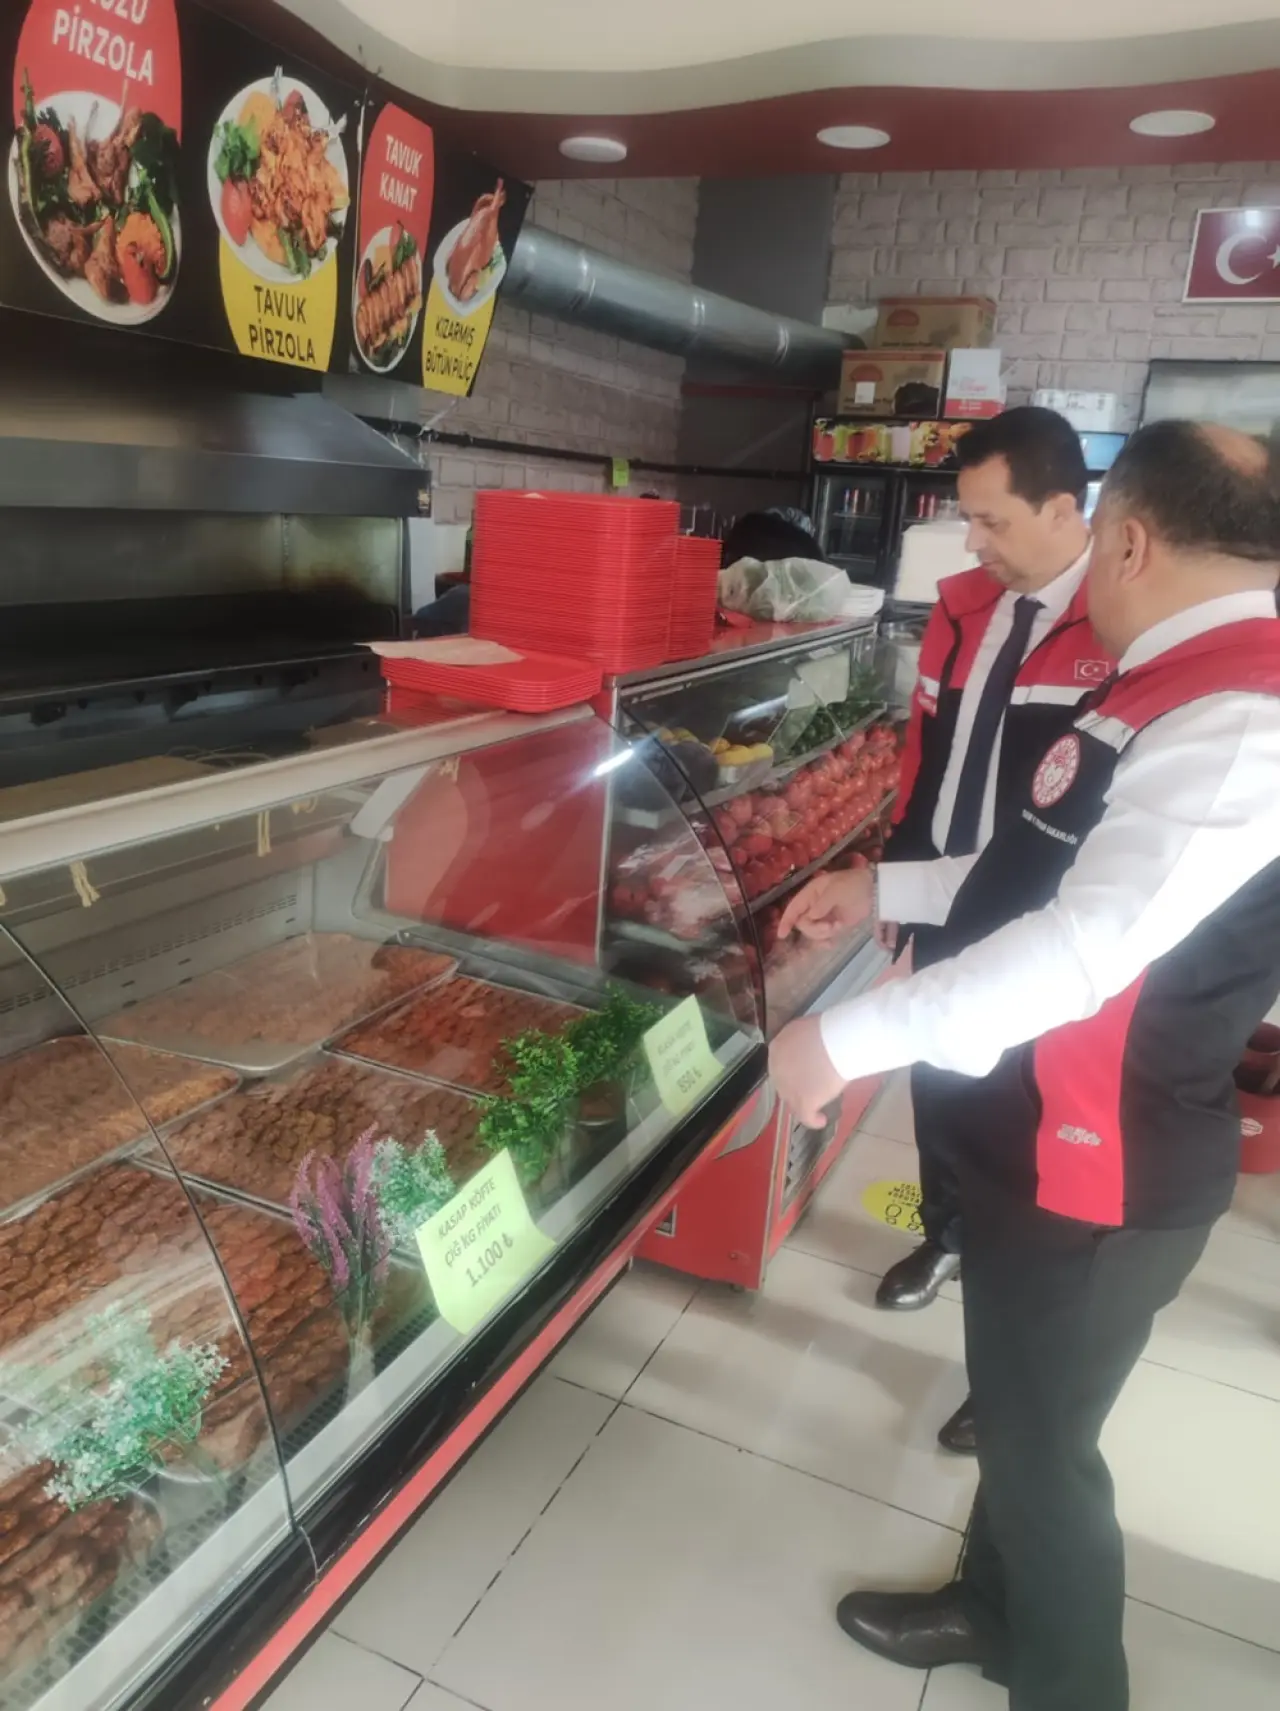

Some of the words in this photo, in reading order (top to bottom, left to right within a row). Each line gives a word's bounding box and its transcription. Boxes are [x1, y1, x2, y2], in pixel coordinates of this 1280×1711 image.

[52, 5, 154, 86] PİRZOLA
[385, 133, 423, 179] TAVUK
[379, 171, 418, 213] KANAT
[253, 285, 307, 324] TAVUK
[248, 318, 316, 364] PİRZOLA
[438, 1203, 468, 1239] KASAP
[468, 1176, 497, 1211] KÖFTE
[460, 1228, 477, 1250] KG
[475, 1203, 502, 1236] FİYATI
[465, 1240, 503, 1287] 1.100
